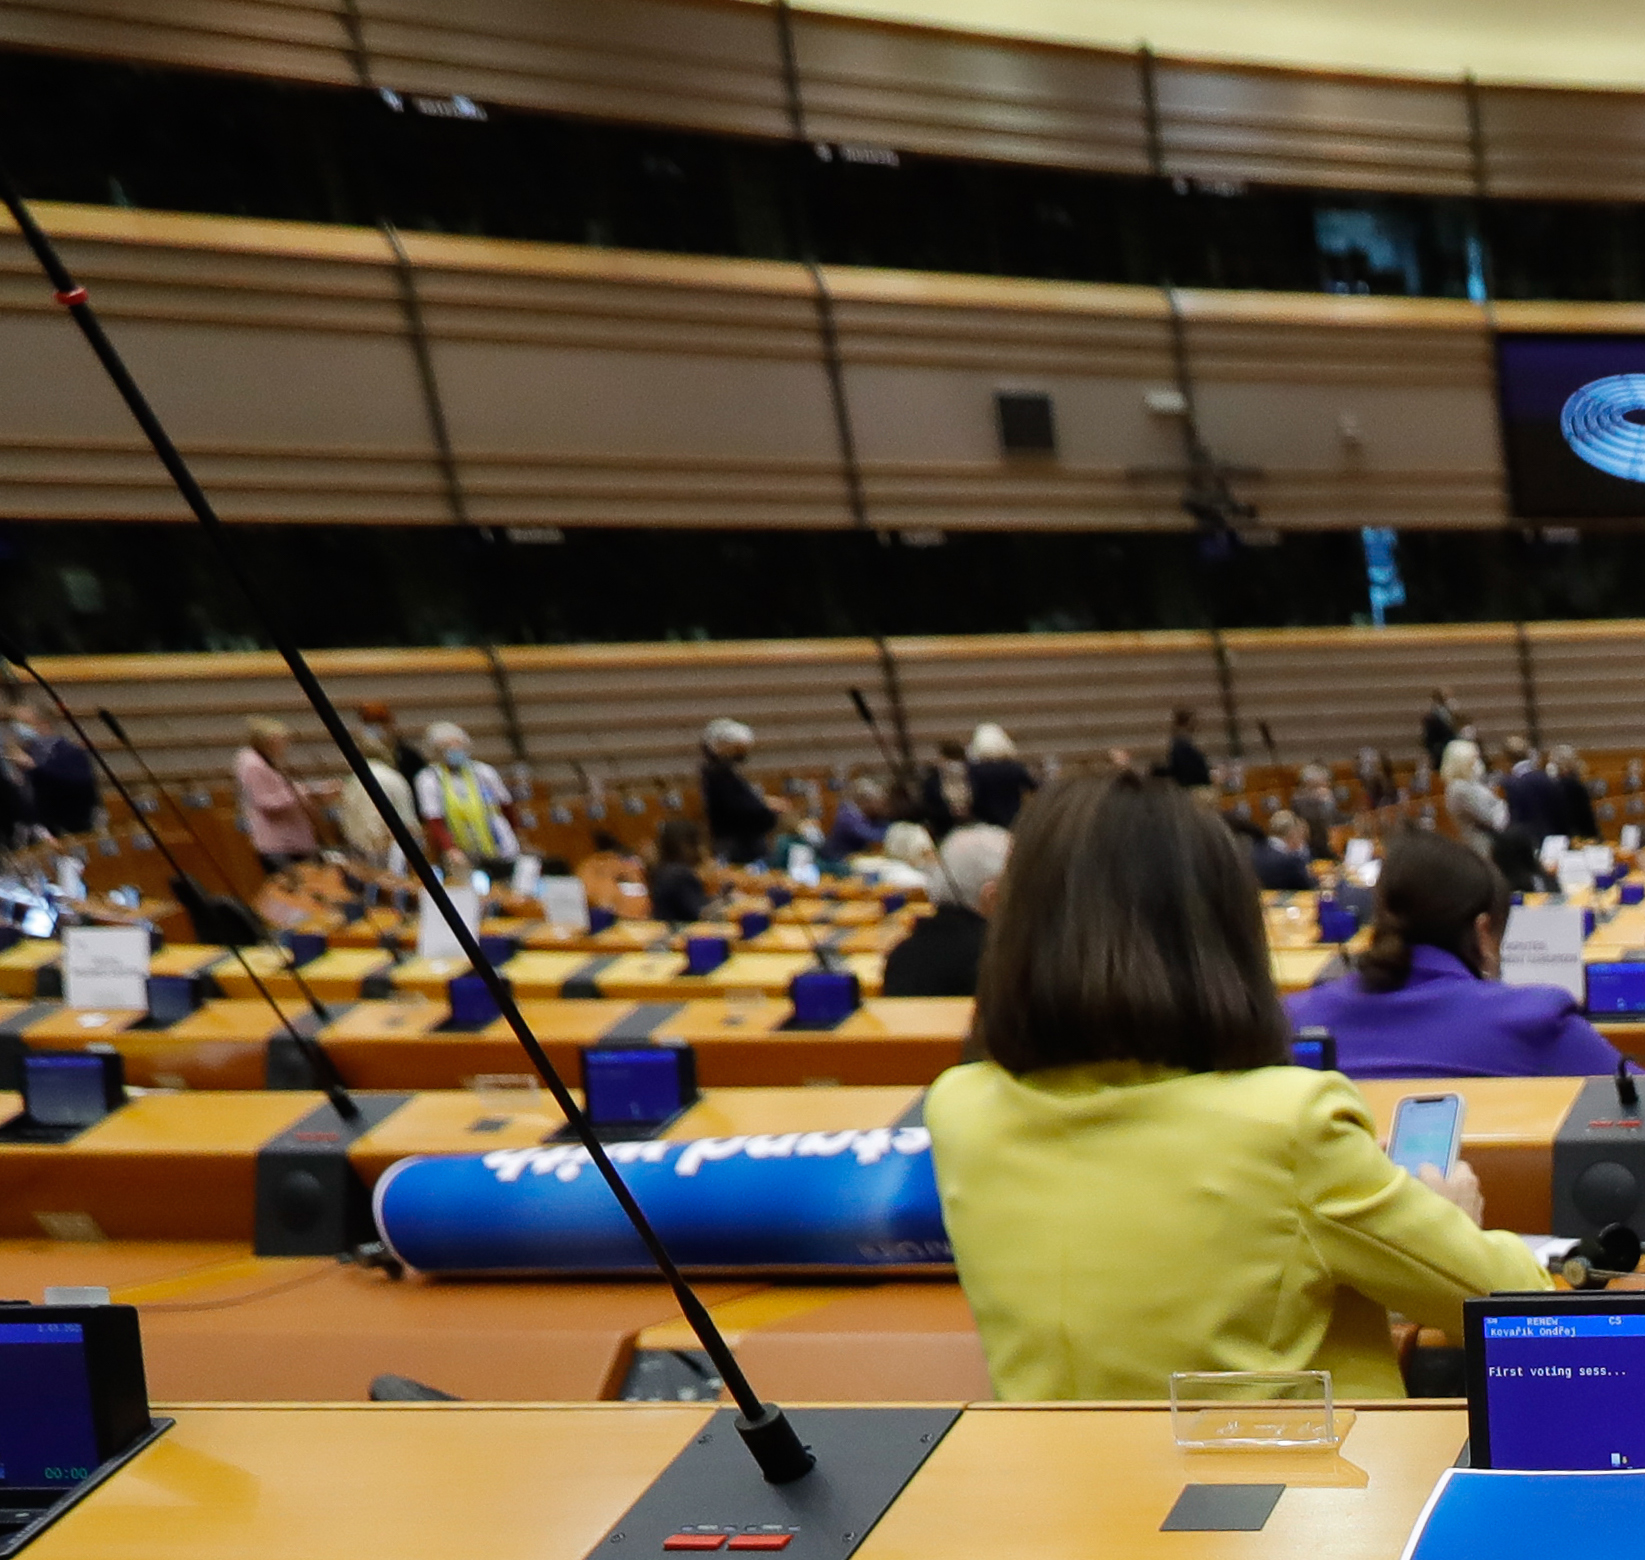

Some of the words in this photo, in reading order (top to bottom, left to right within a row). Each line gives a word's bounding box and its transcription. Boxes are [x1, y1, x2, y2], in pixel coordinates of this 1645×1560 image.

[1488, 1366, 1524, 1377] First
[1530, 1366, 1573, 1379] voting
[1578, 1367, 1627, 1377] sess...
[44, 1466, 89, 1480] 00:00
